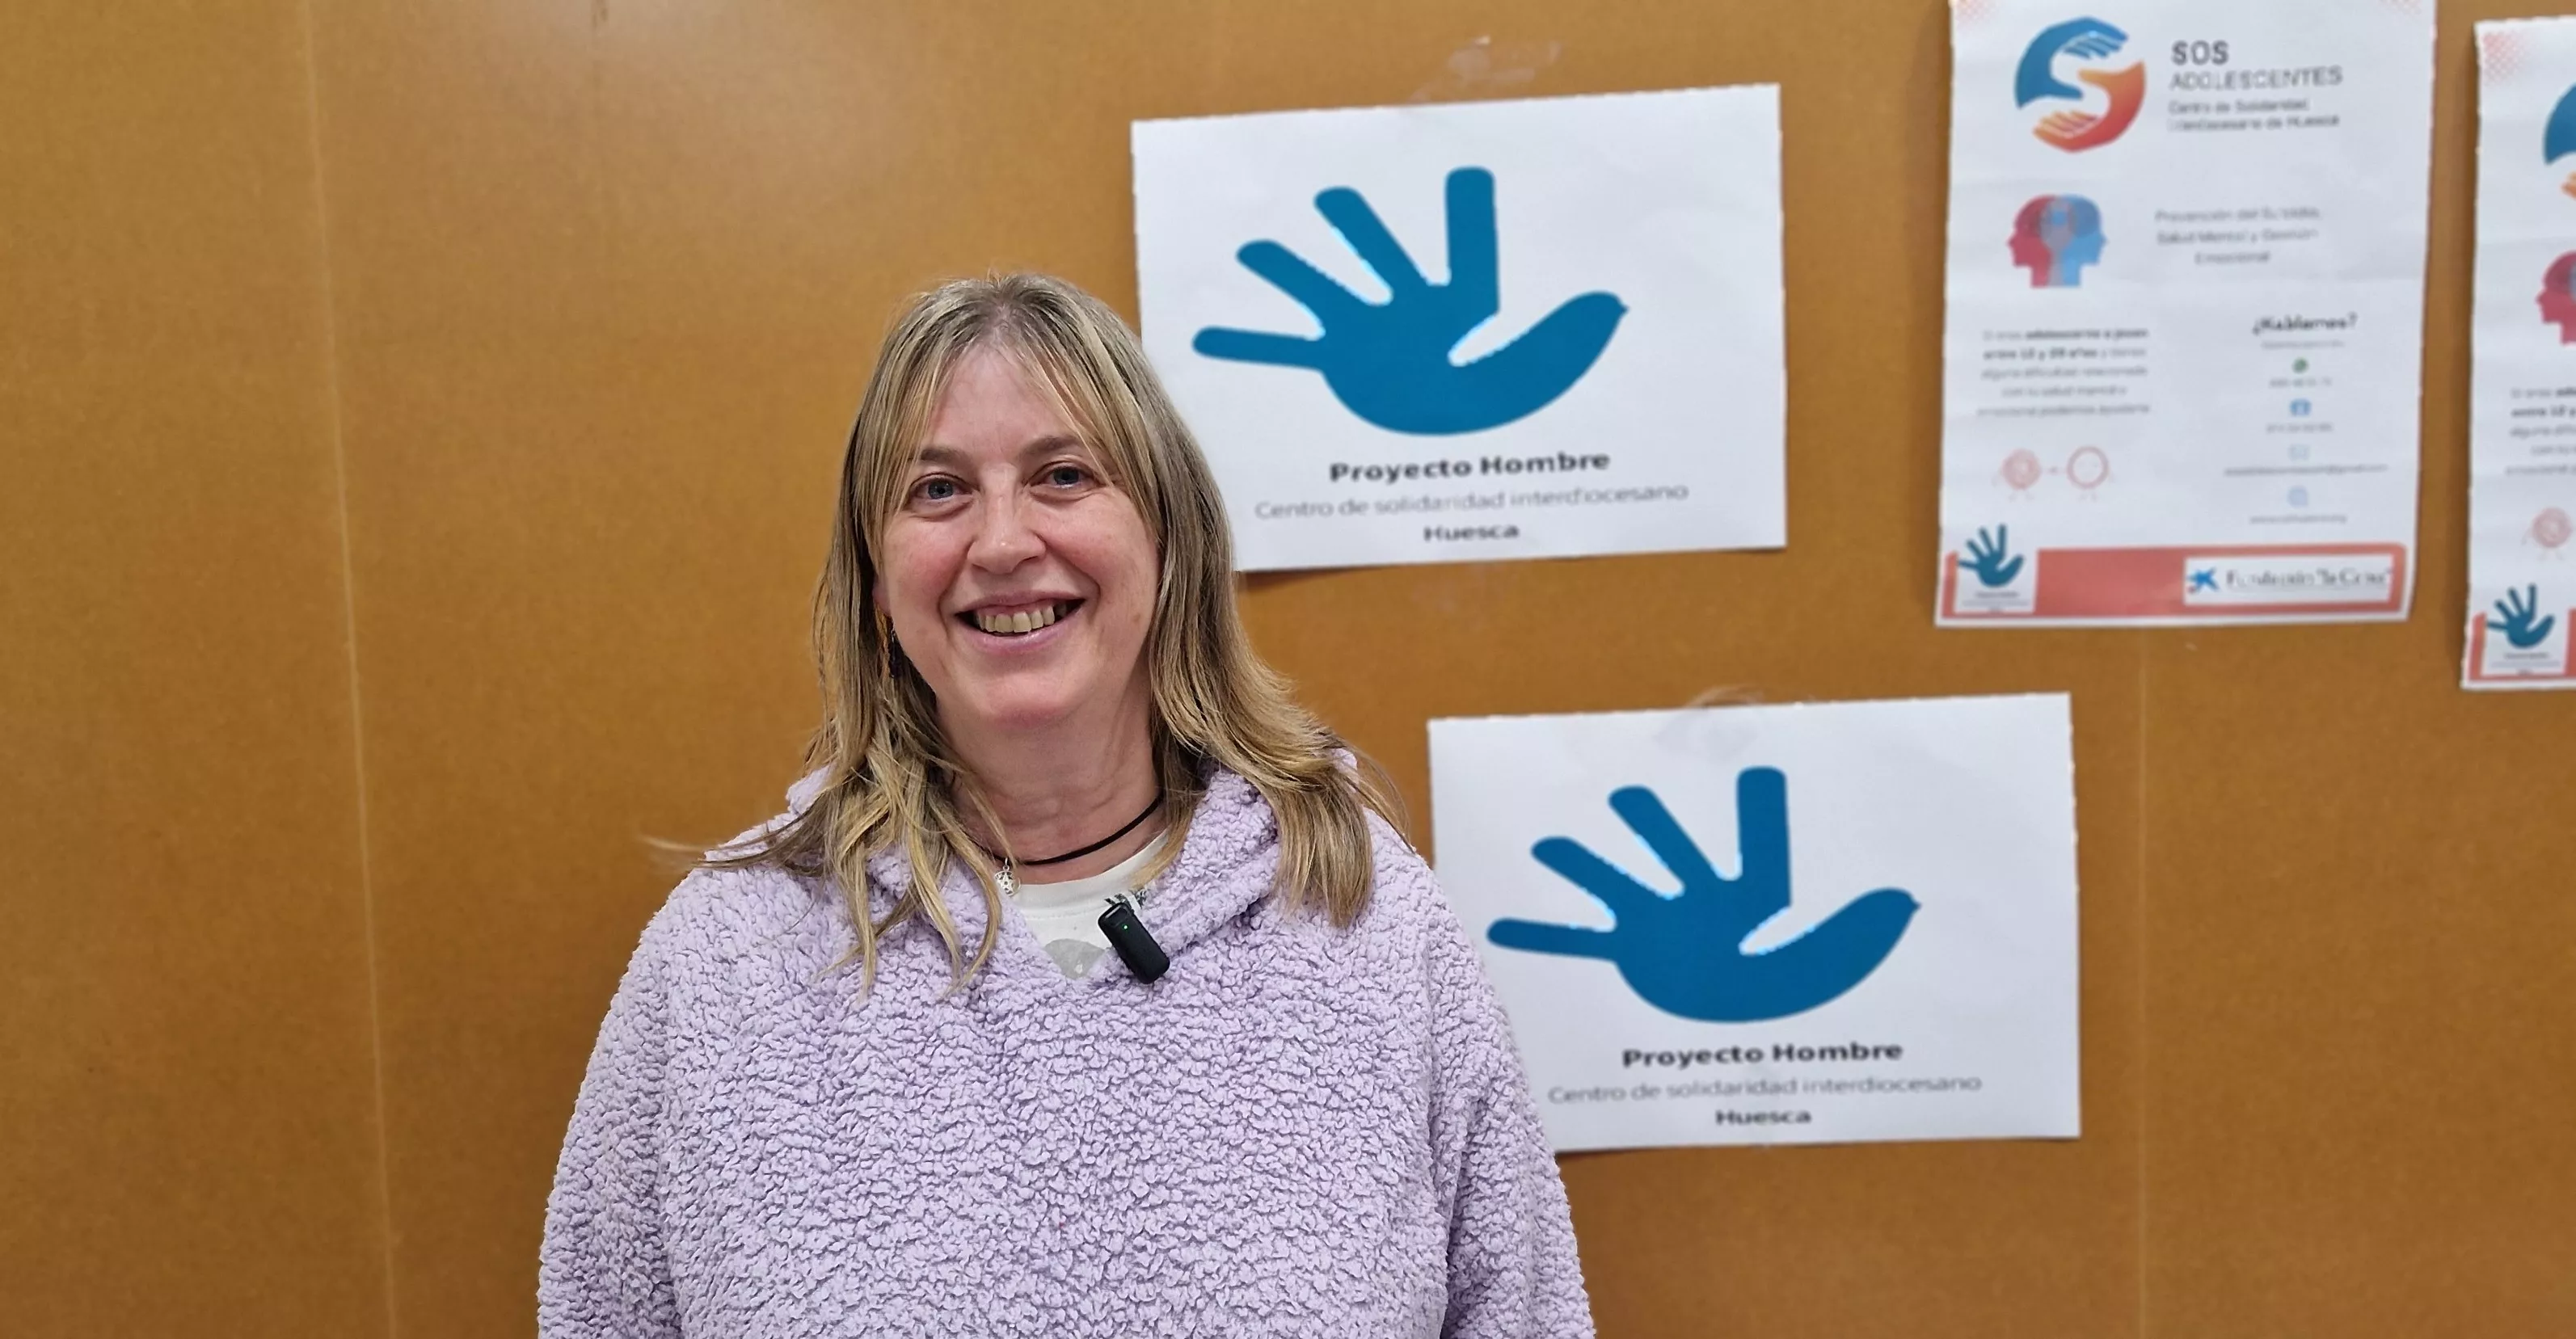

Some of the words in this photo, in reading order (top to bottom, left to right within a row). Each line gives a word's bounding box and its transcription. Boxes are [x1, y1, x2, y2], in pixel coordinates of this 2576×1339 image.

[2171, 40, 2229, 65] SOS
[2168, 65, 2343, 91] ADOLESCENTES
[1330, 460, 1472, 485] Proyecto
[1480, 452, 1610, 477] Hombre
[1255, 499, 1334, 520] Centro
[1339, 497, 1369, 516] de
[1375, 491, 1504, 515] solidaridad
[1423, 523, 1520, 542] Huesca
[1622, 1047, 1764, 1070] Proyecto
[1773, 1041, 1904, 1063] Hombre
[1548, 1085, 1626, 1105] Centro
[1631, 1083, 1662, 1101] de
[1667, 1078, 1797, 1099] solidaridad
[1802, 1073, 1982, 1095] interdiocesano
[1716, 1106, 1812, 1126] Huesca
